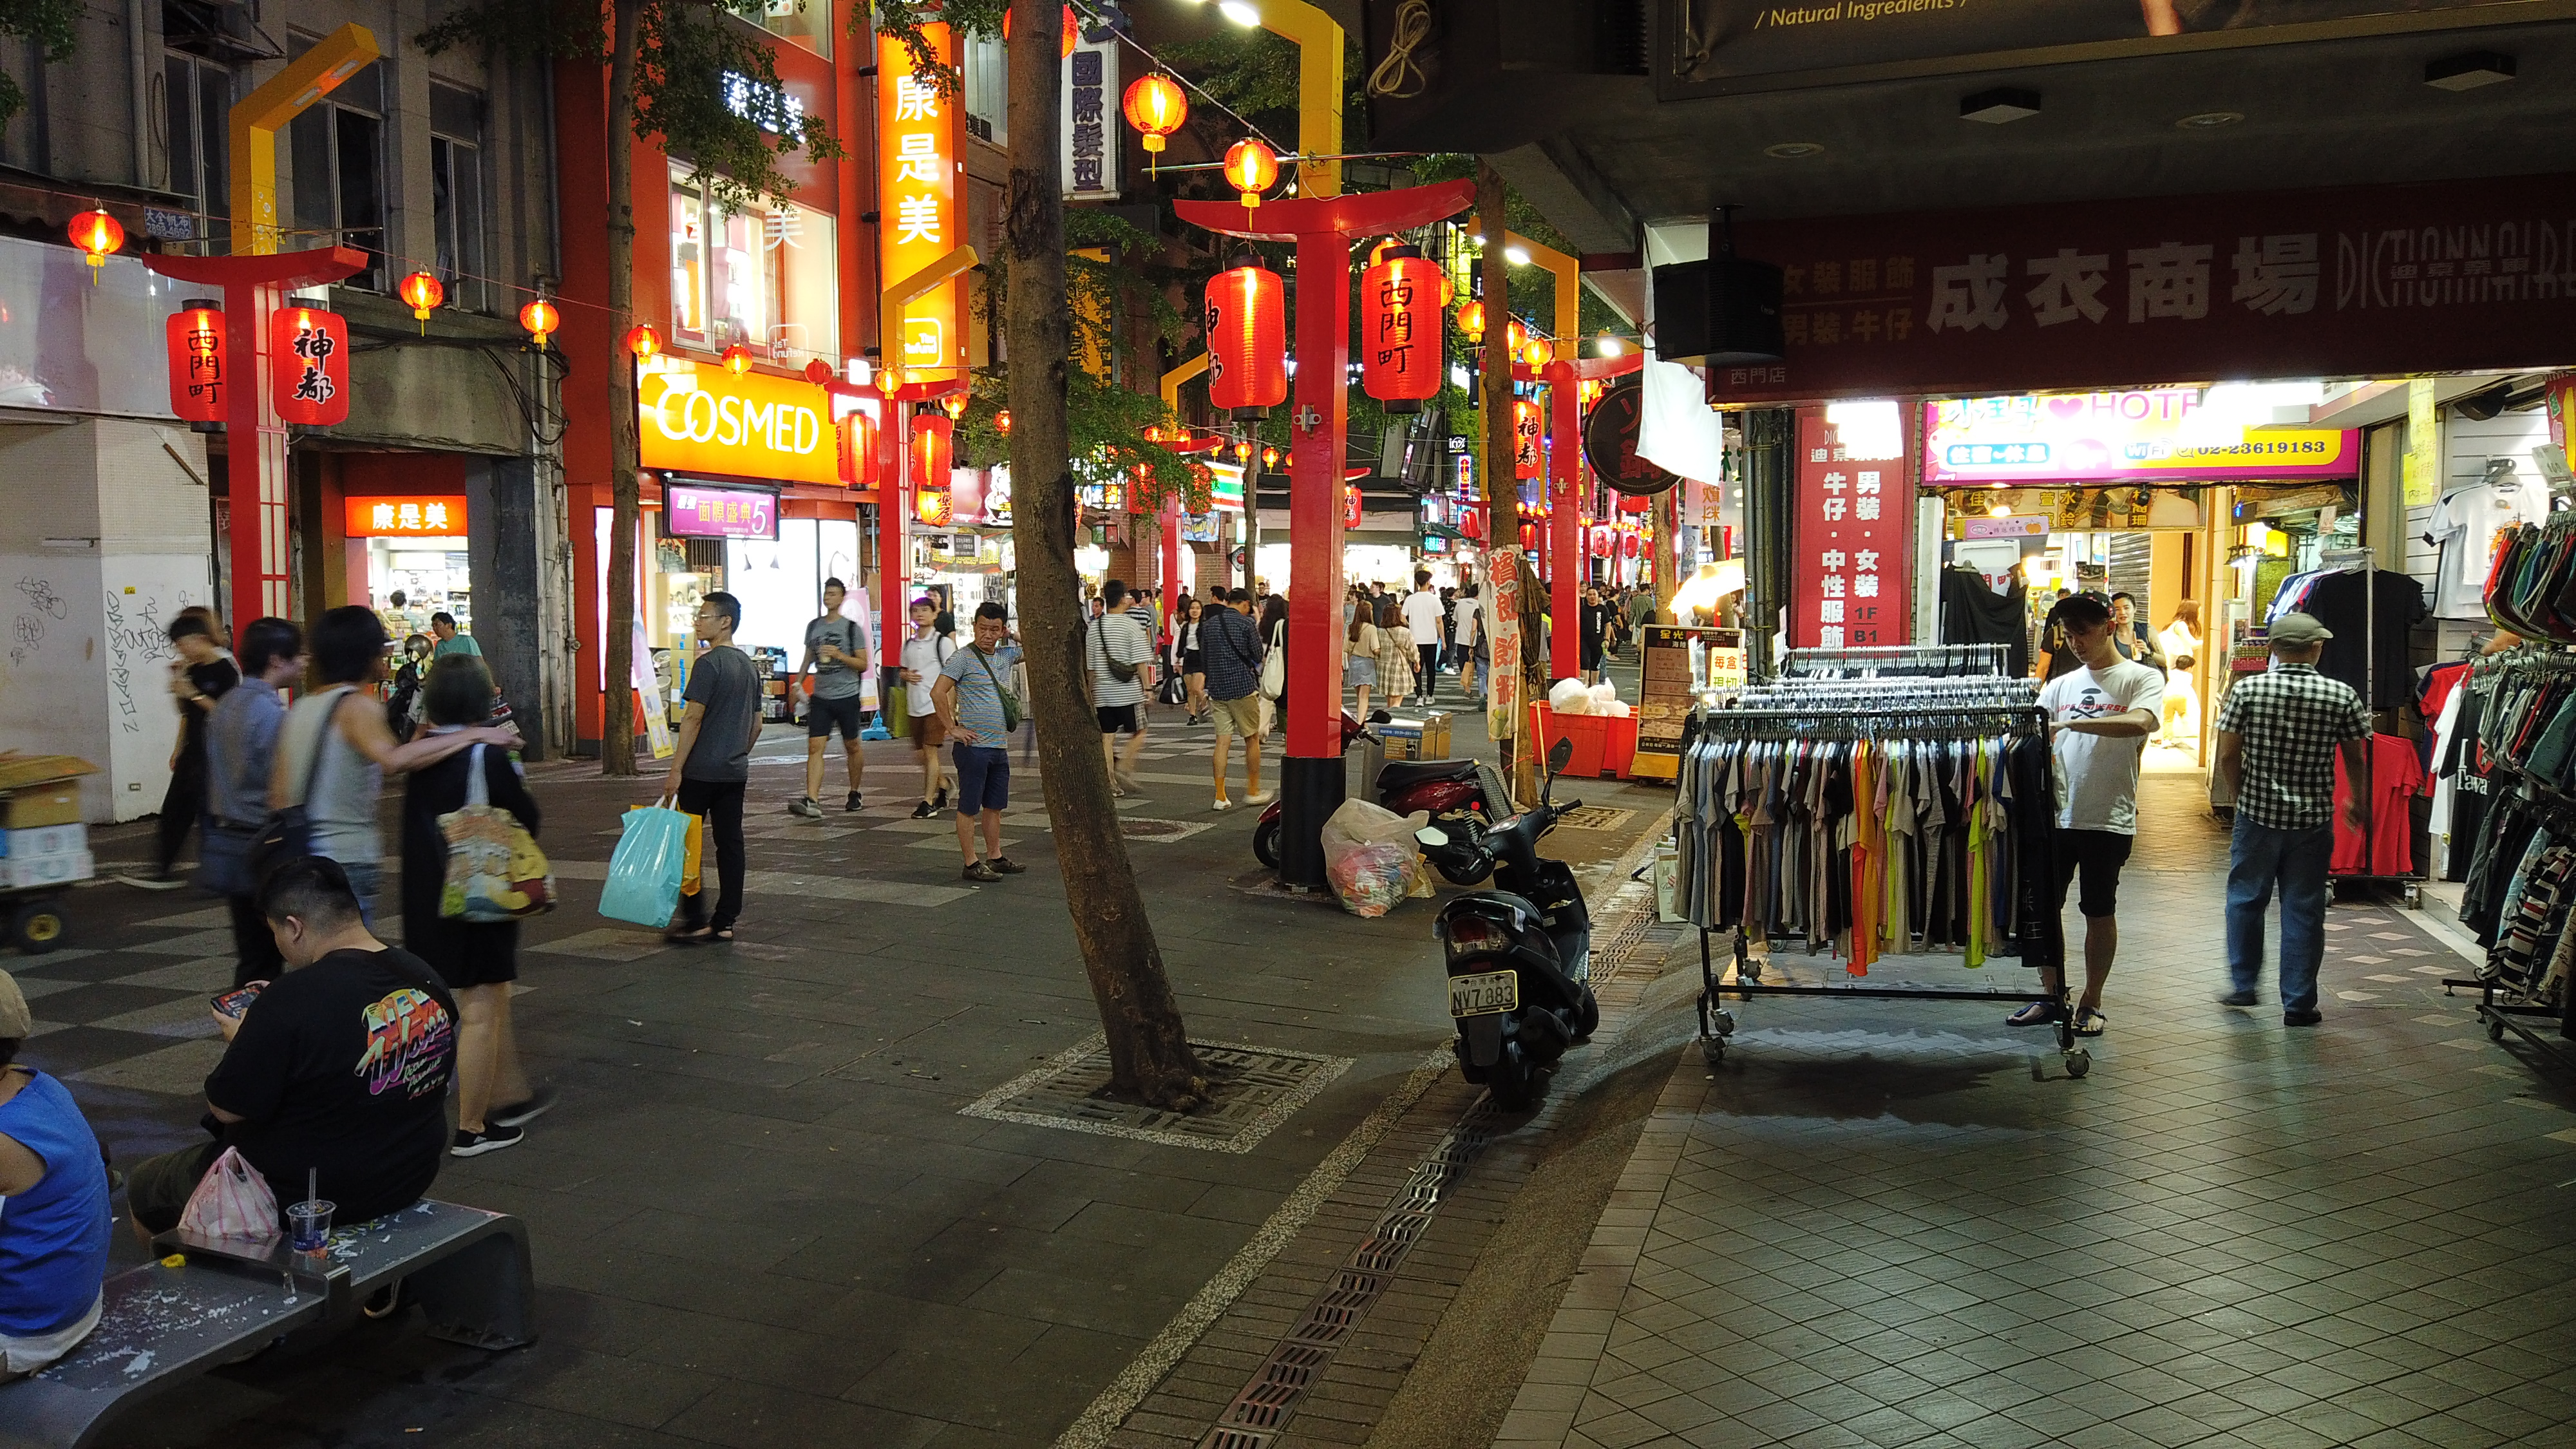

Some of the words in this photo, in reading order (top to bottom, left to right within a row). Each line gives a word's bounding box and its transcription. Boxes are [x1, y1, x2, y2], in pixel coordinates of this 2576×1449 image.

[1770, 2, 1841, 27] Natural
[1072, 51, 1103, 192] 國際髮型
[895, 75, 941, 245] 康是美
[1926, 232, 2319, 334] 成衣商場
[1378, 278, 1414, 374] 西門町
[188, 329, 223, 404] 西門町
[292, 328, 335, 404] 神都
[1730, 366, 1786, 385] 西門店
[655, 388, 820, 455] COSMED
[1516, 416, 1540, 468] 神都
[372, 502, 448, 530] 康是美
[699, 500, 751, 524] 面膜盛典
[1854, 607, 1878, 620] 1F
[1854, 630, 1878, 643] B1
